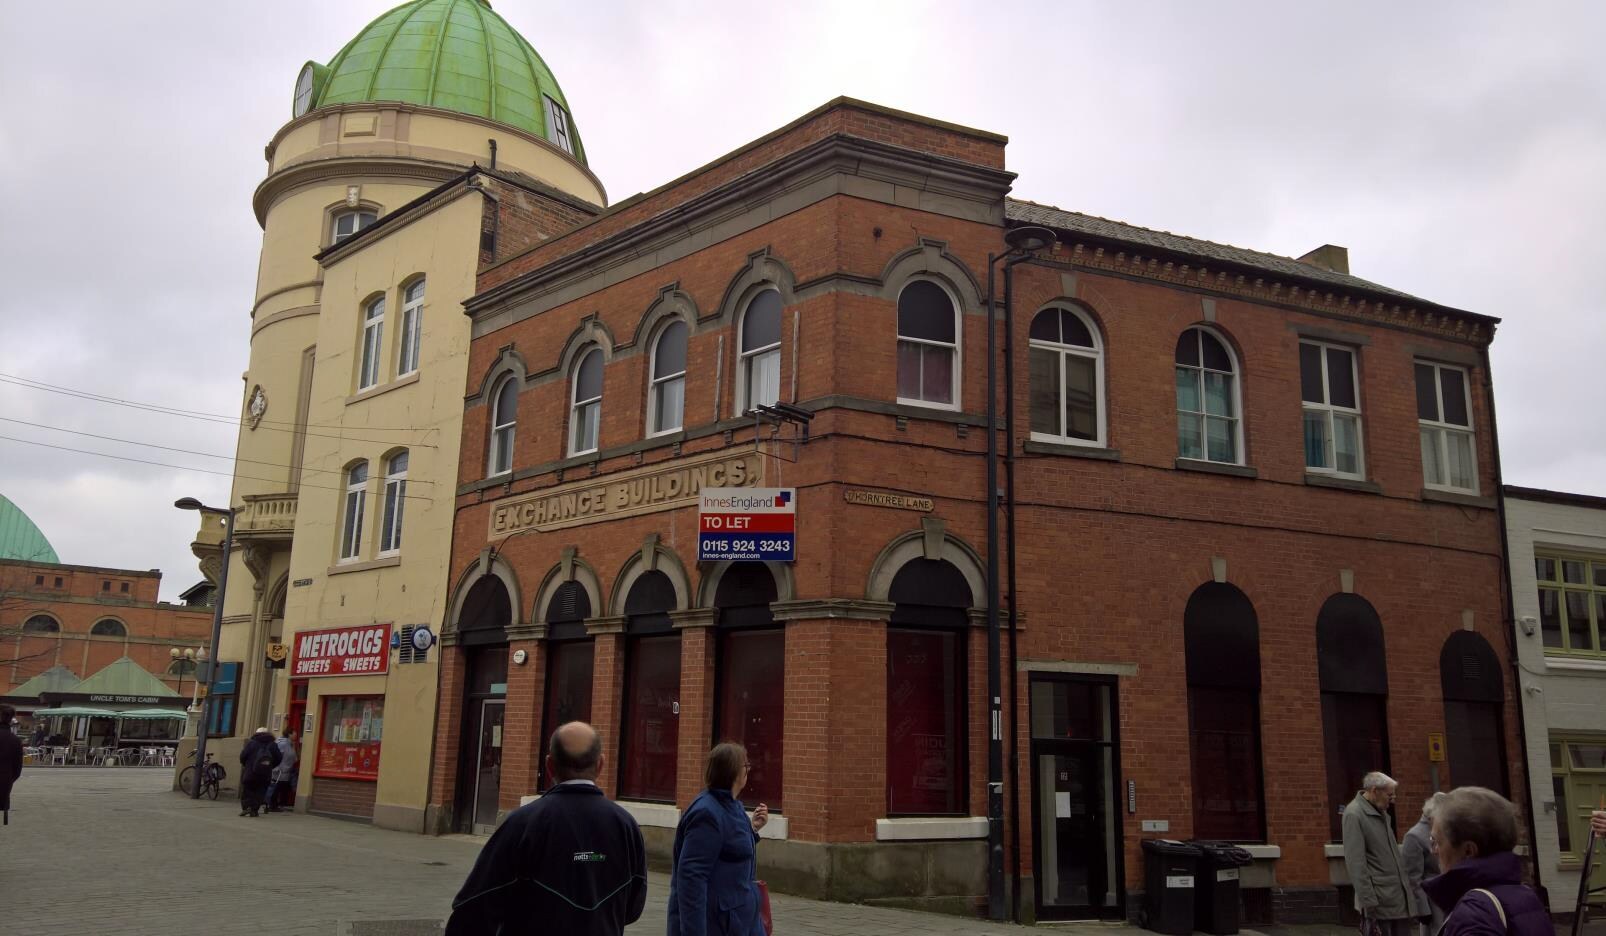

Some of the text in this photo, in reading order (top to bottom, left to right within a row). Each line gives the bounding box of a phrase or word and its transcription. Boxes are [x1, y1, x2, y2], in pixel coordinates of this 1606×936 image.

[704, 496, 773, 510] InnesEngland
[847, 491, 930, 510] THORNTREE LANE
[494, 487, 606, 530] EXCHANGE
[703, 516, 751, 529] TO LET
[702, 540, 790, 552] 0115 924 3243
[702, 552, 760, 560] innes-england.com
[298, 629, 384, 659] METROCIGS
[296, 656, 380, 674] SWEETS SWEETS
[115, 695, 137, 703] TOM'S
